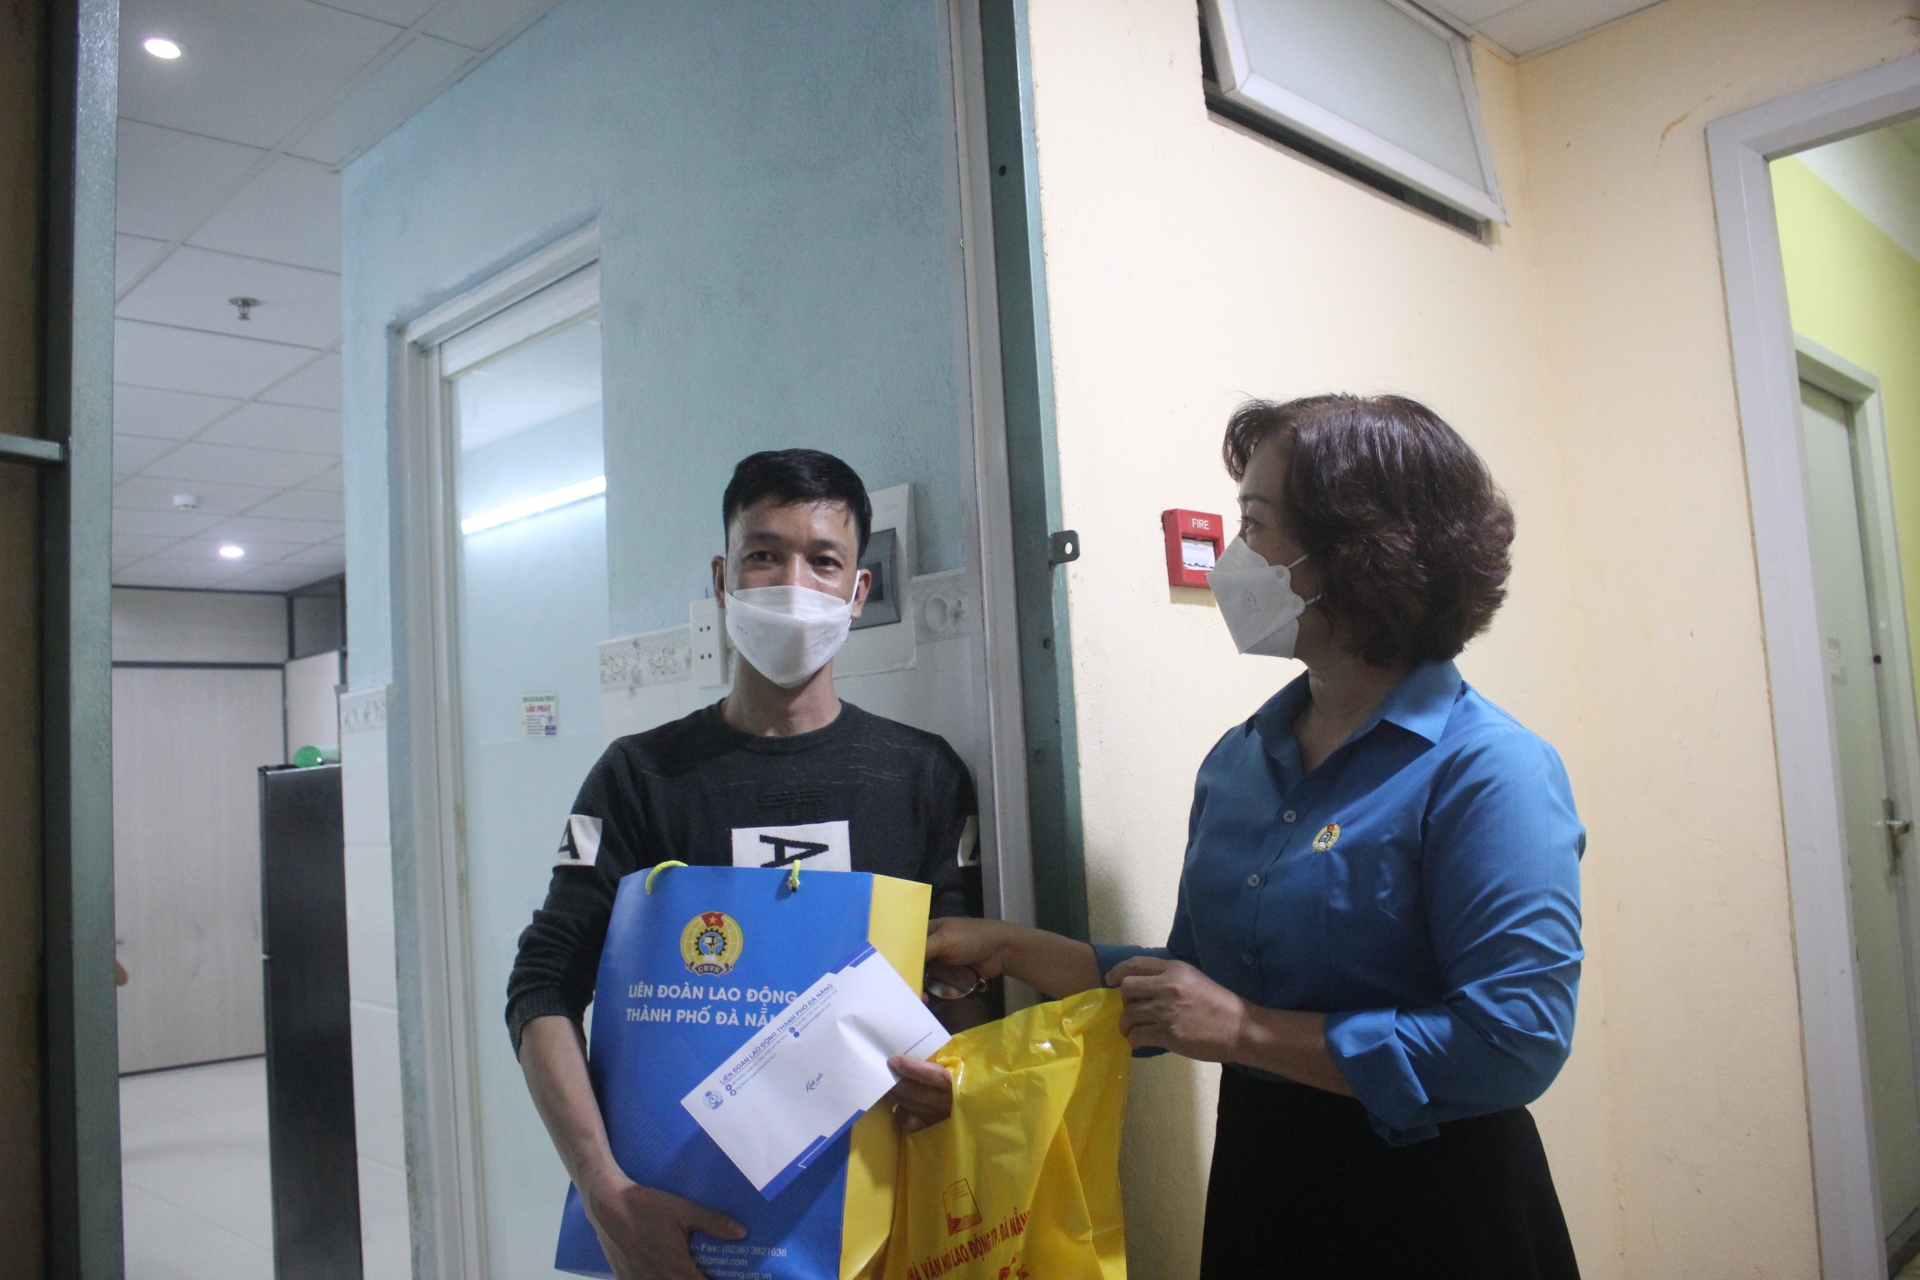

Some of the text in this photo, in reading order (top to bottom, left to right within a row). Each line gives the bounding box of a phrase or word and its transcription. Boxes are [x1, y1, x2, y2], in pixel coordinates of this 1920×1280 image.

[1191, 518, 1210, 530] FIRE
[759, 834, 829, 868] A
[628, 981, 799, 1007] LIÊN ĐOÀN LAO ĐỘNG
[626, 1004, 672, 1022] THÀNH
[676, 1004, 712, 1024] PHỐ
[715, 1008, 740, 1026] ĐÀ
[732, 1057, 750, 1074] ĐOÀN
[748, 1046, 761, 1060] LAO
[776, 1014, 797, 1033] THÀNH
[701, 1243, 720, 1253] Fax:
[750, 1246, 787, 1257] 3821638
[950, 1243, 970, 1268] LAO
